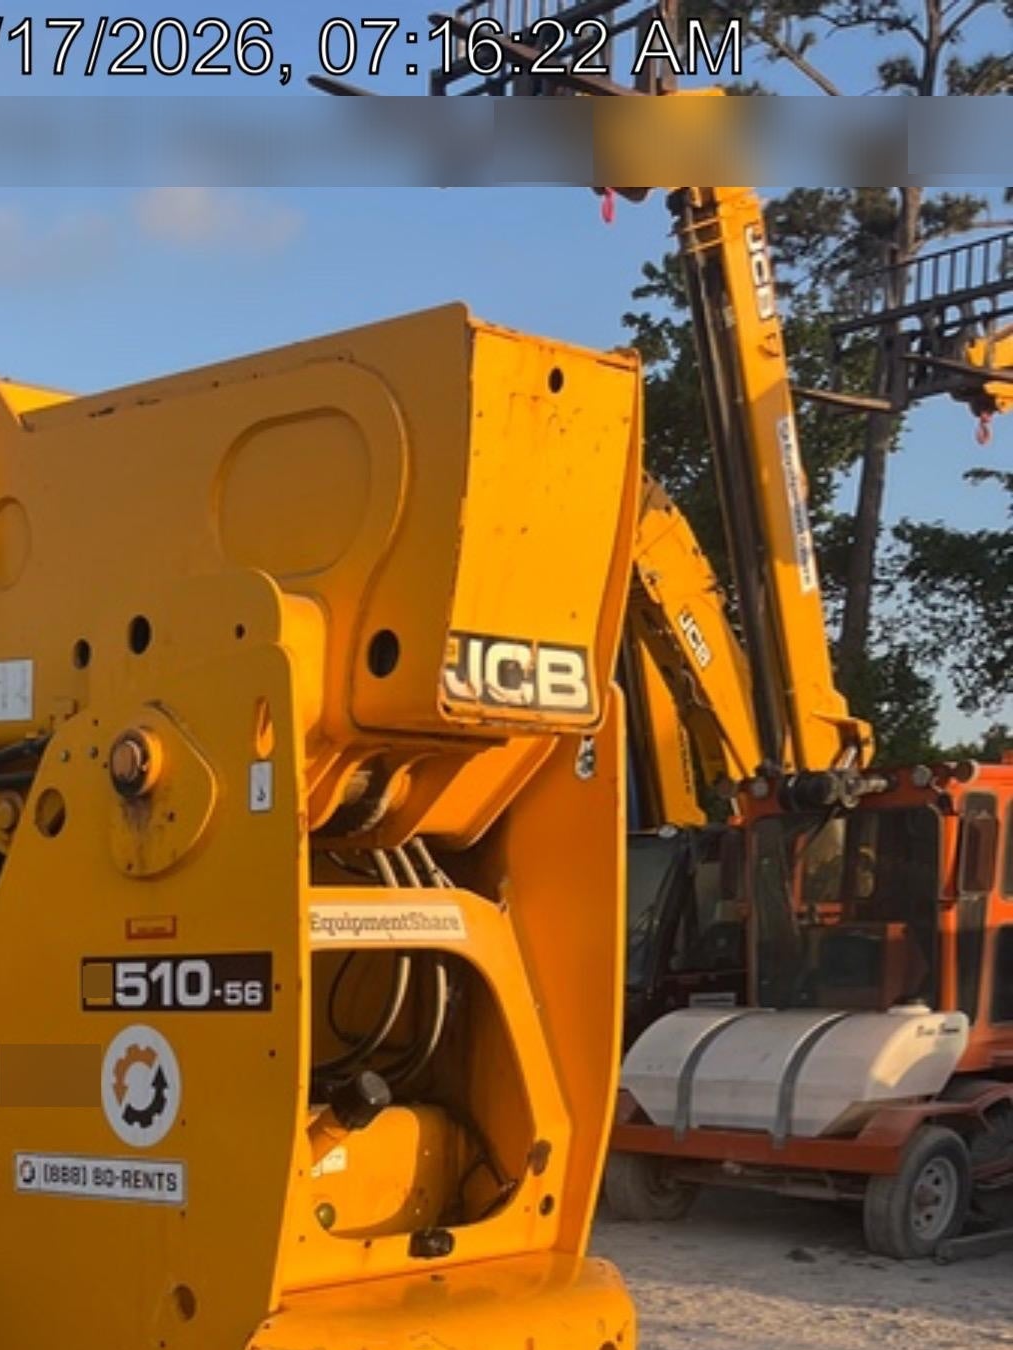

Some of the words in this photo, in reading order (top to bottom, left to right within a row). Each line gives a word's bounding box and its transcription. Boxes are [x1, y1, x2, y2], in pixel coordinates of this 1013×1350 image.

[678, 614, 711, 667] JCB
[444, 638, 588, 708] JCB
[310, 912, 460, 936] EquipmentShare
[92, 1167, 178, 1192] 80-RENTS
